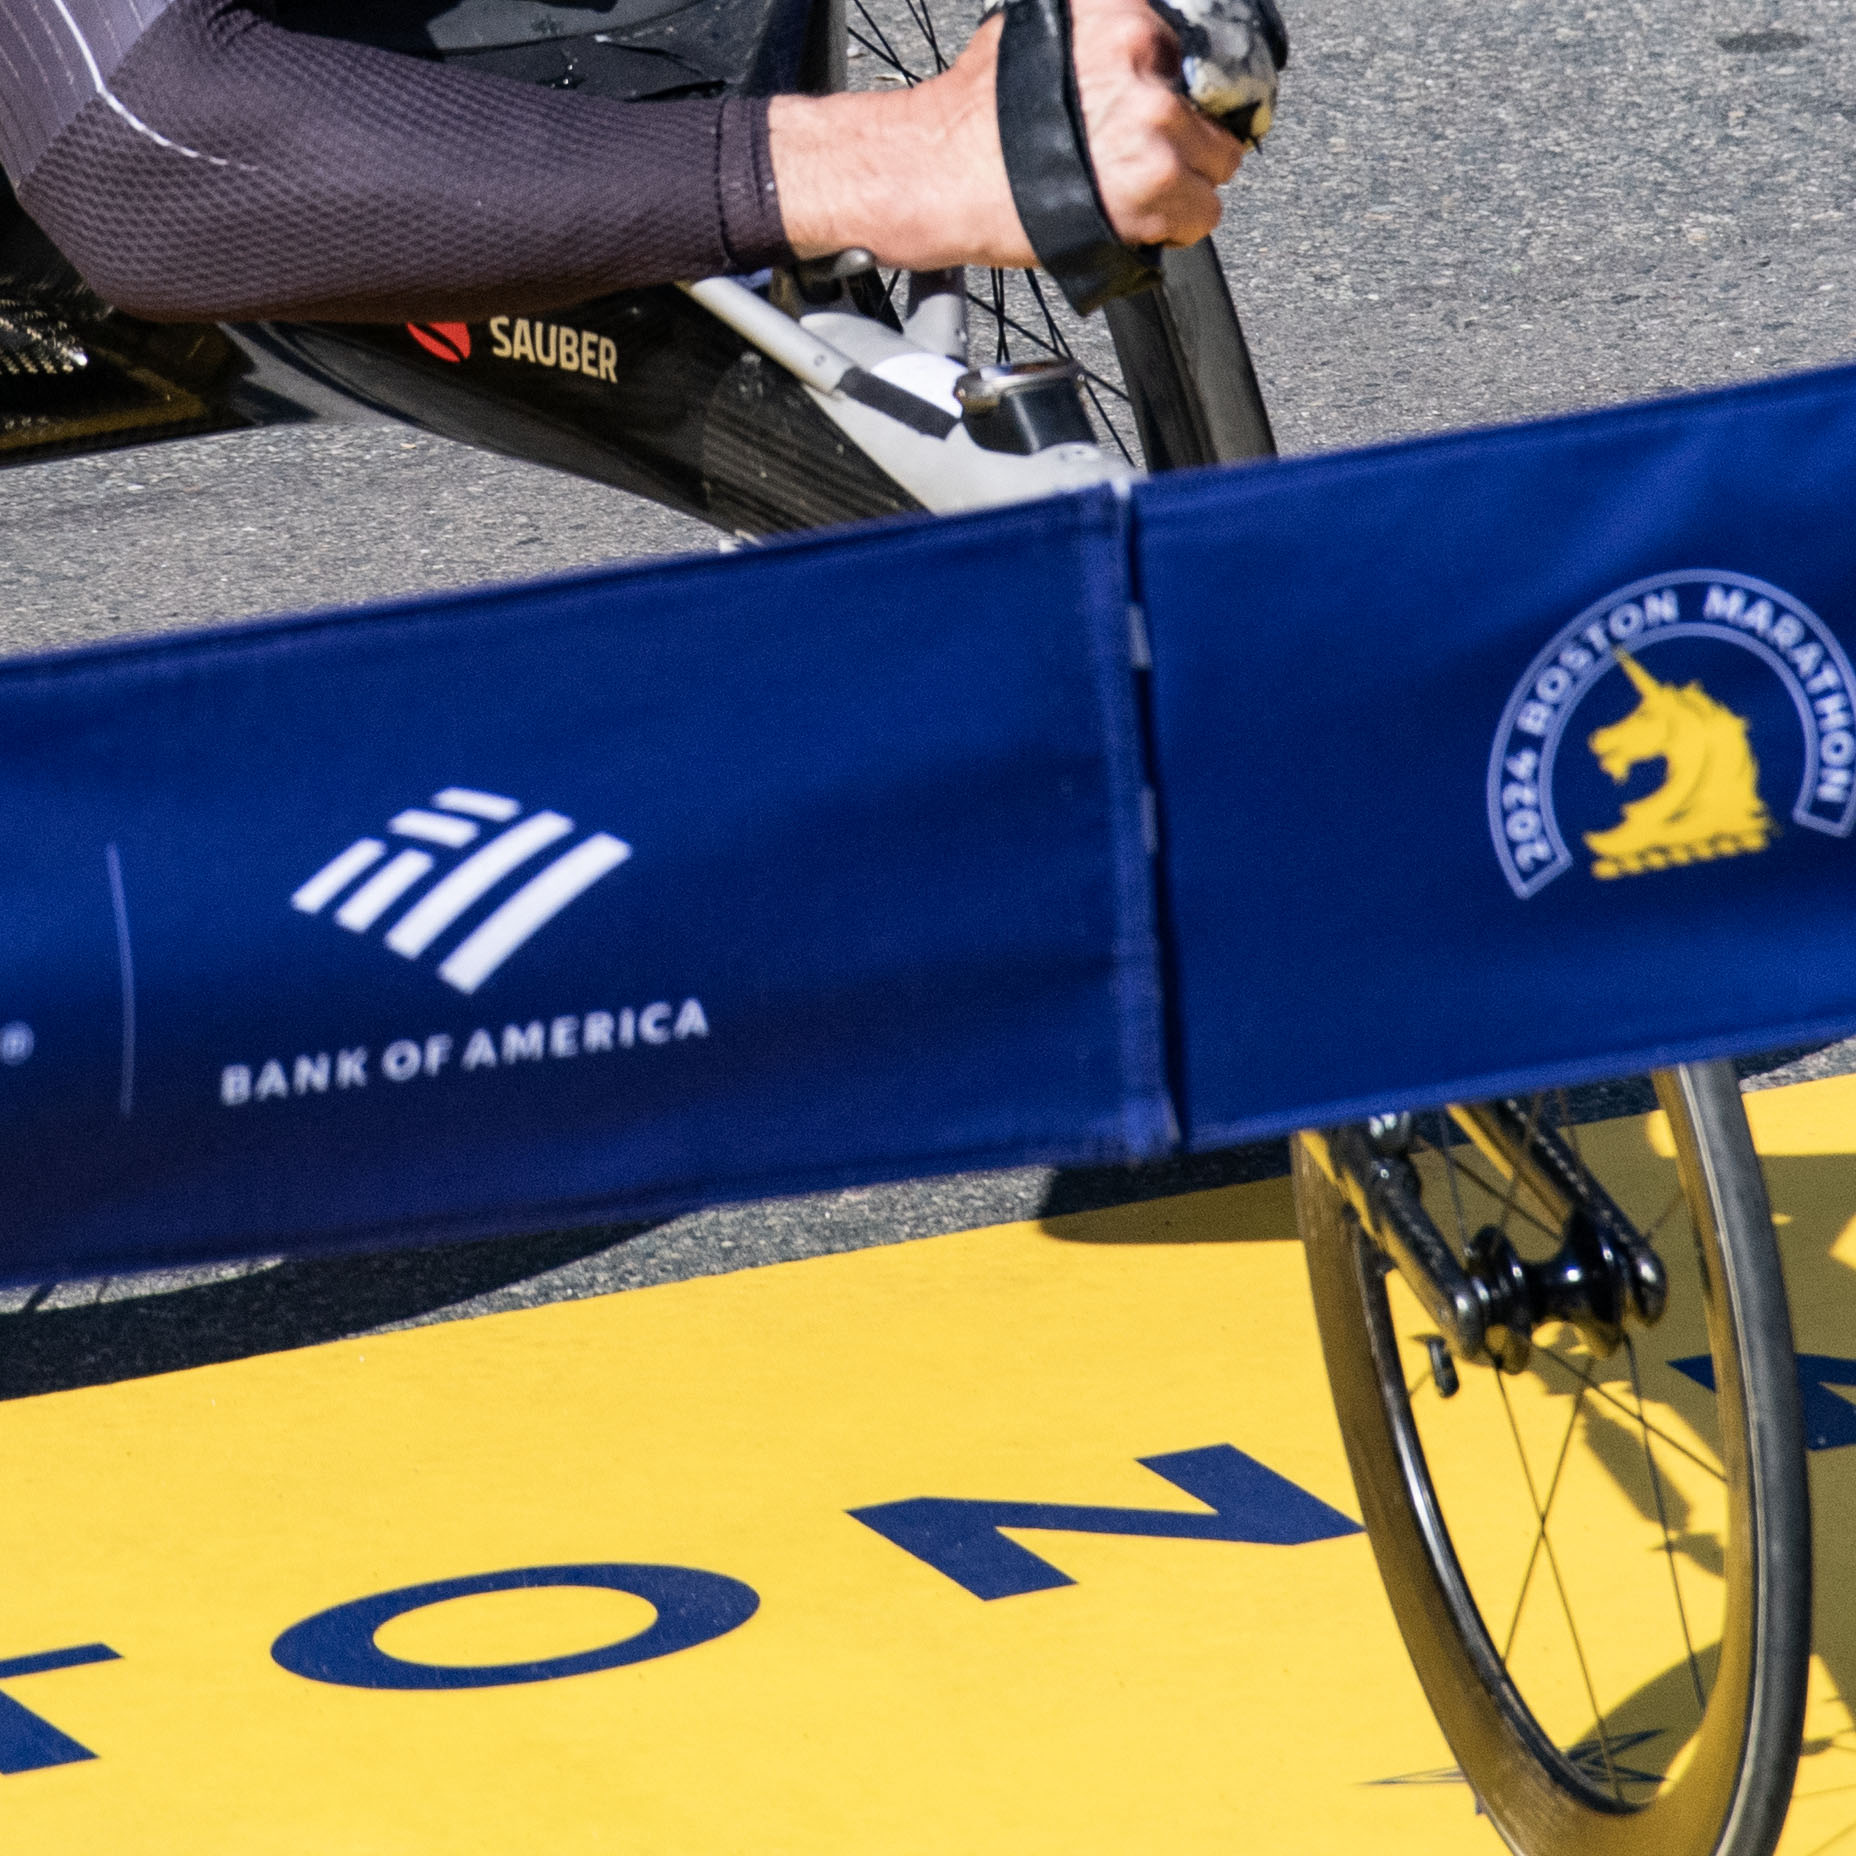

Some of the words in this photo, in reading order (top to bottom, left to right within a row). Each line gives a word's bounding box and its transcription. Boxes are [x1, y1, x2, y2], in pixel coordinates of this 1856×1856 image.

[488, 314, 618, 384] SAUBER
[1518, 589, 1679, 737] BOSTON
[1703, 585, 1853, 805] MARATHON
[1500, 751, 1545, 874] 2024
[220, 1047, 367, 1105] BANK
[380, 1034, 451, 1082] OF
[463, 997, 709, 1069] AMERICA
